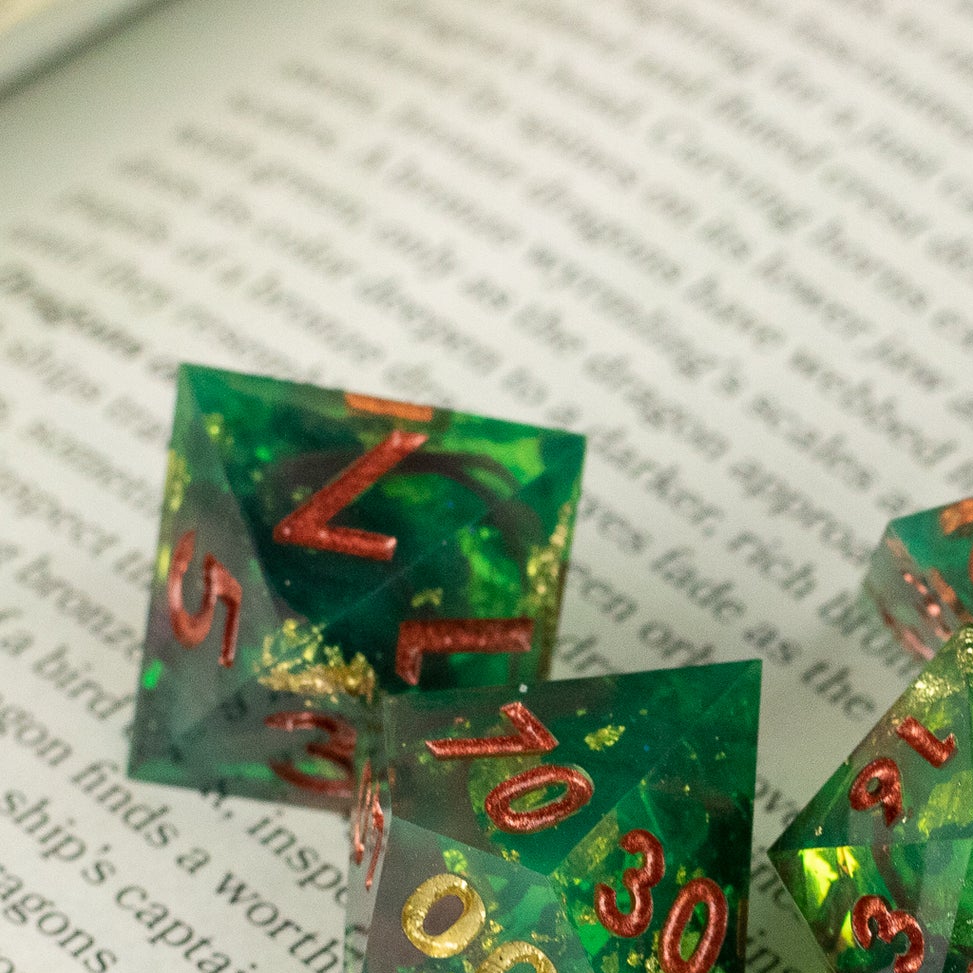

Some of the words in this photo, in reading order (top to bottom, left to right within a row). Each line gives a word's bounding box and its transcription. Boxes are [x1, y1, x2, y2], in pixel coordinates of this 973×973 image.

[166, 530, 242, 668] 5
[71, 763, 178, 848] finds
[175, 848, 211, 876] a
[425, 702, 594, 834] 10
[4, 791, 116, 886] ship's
